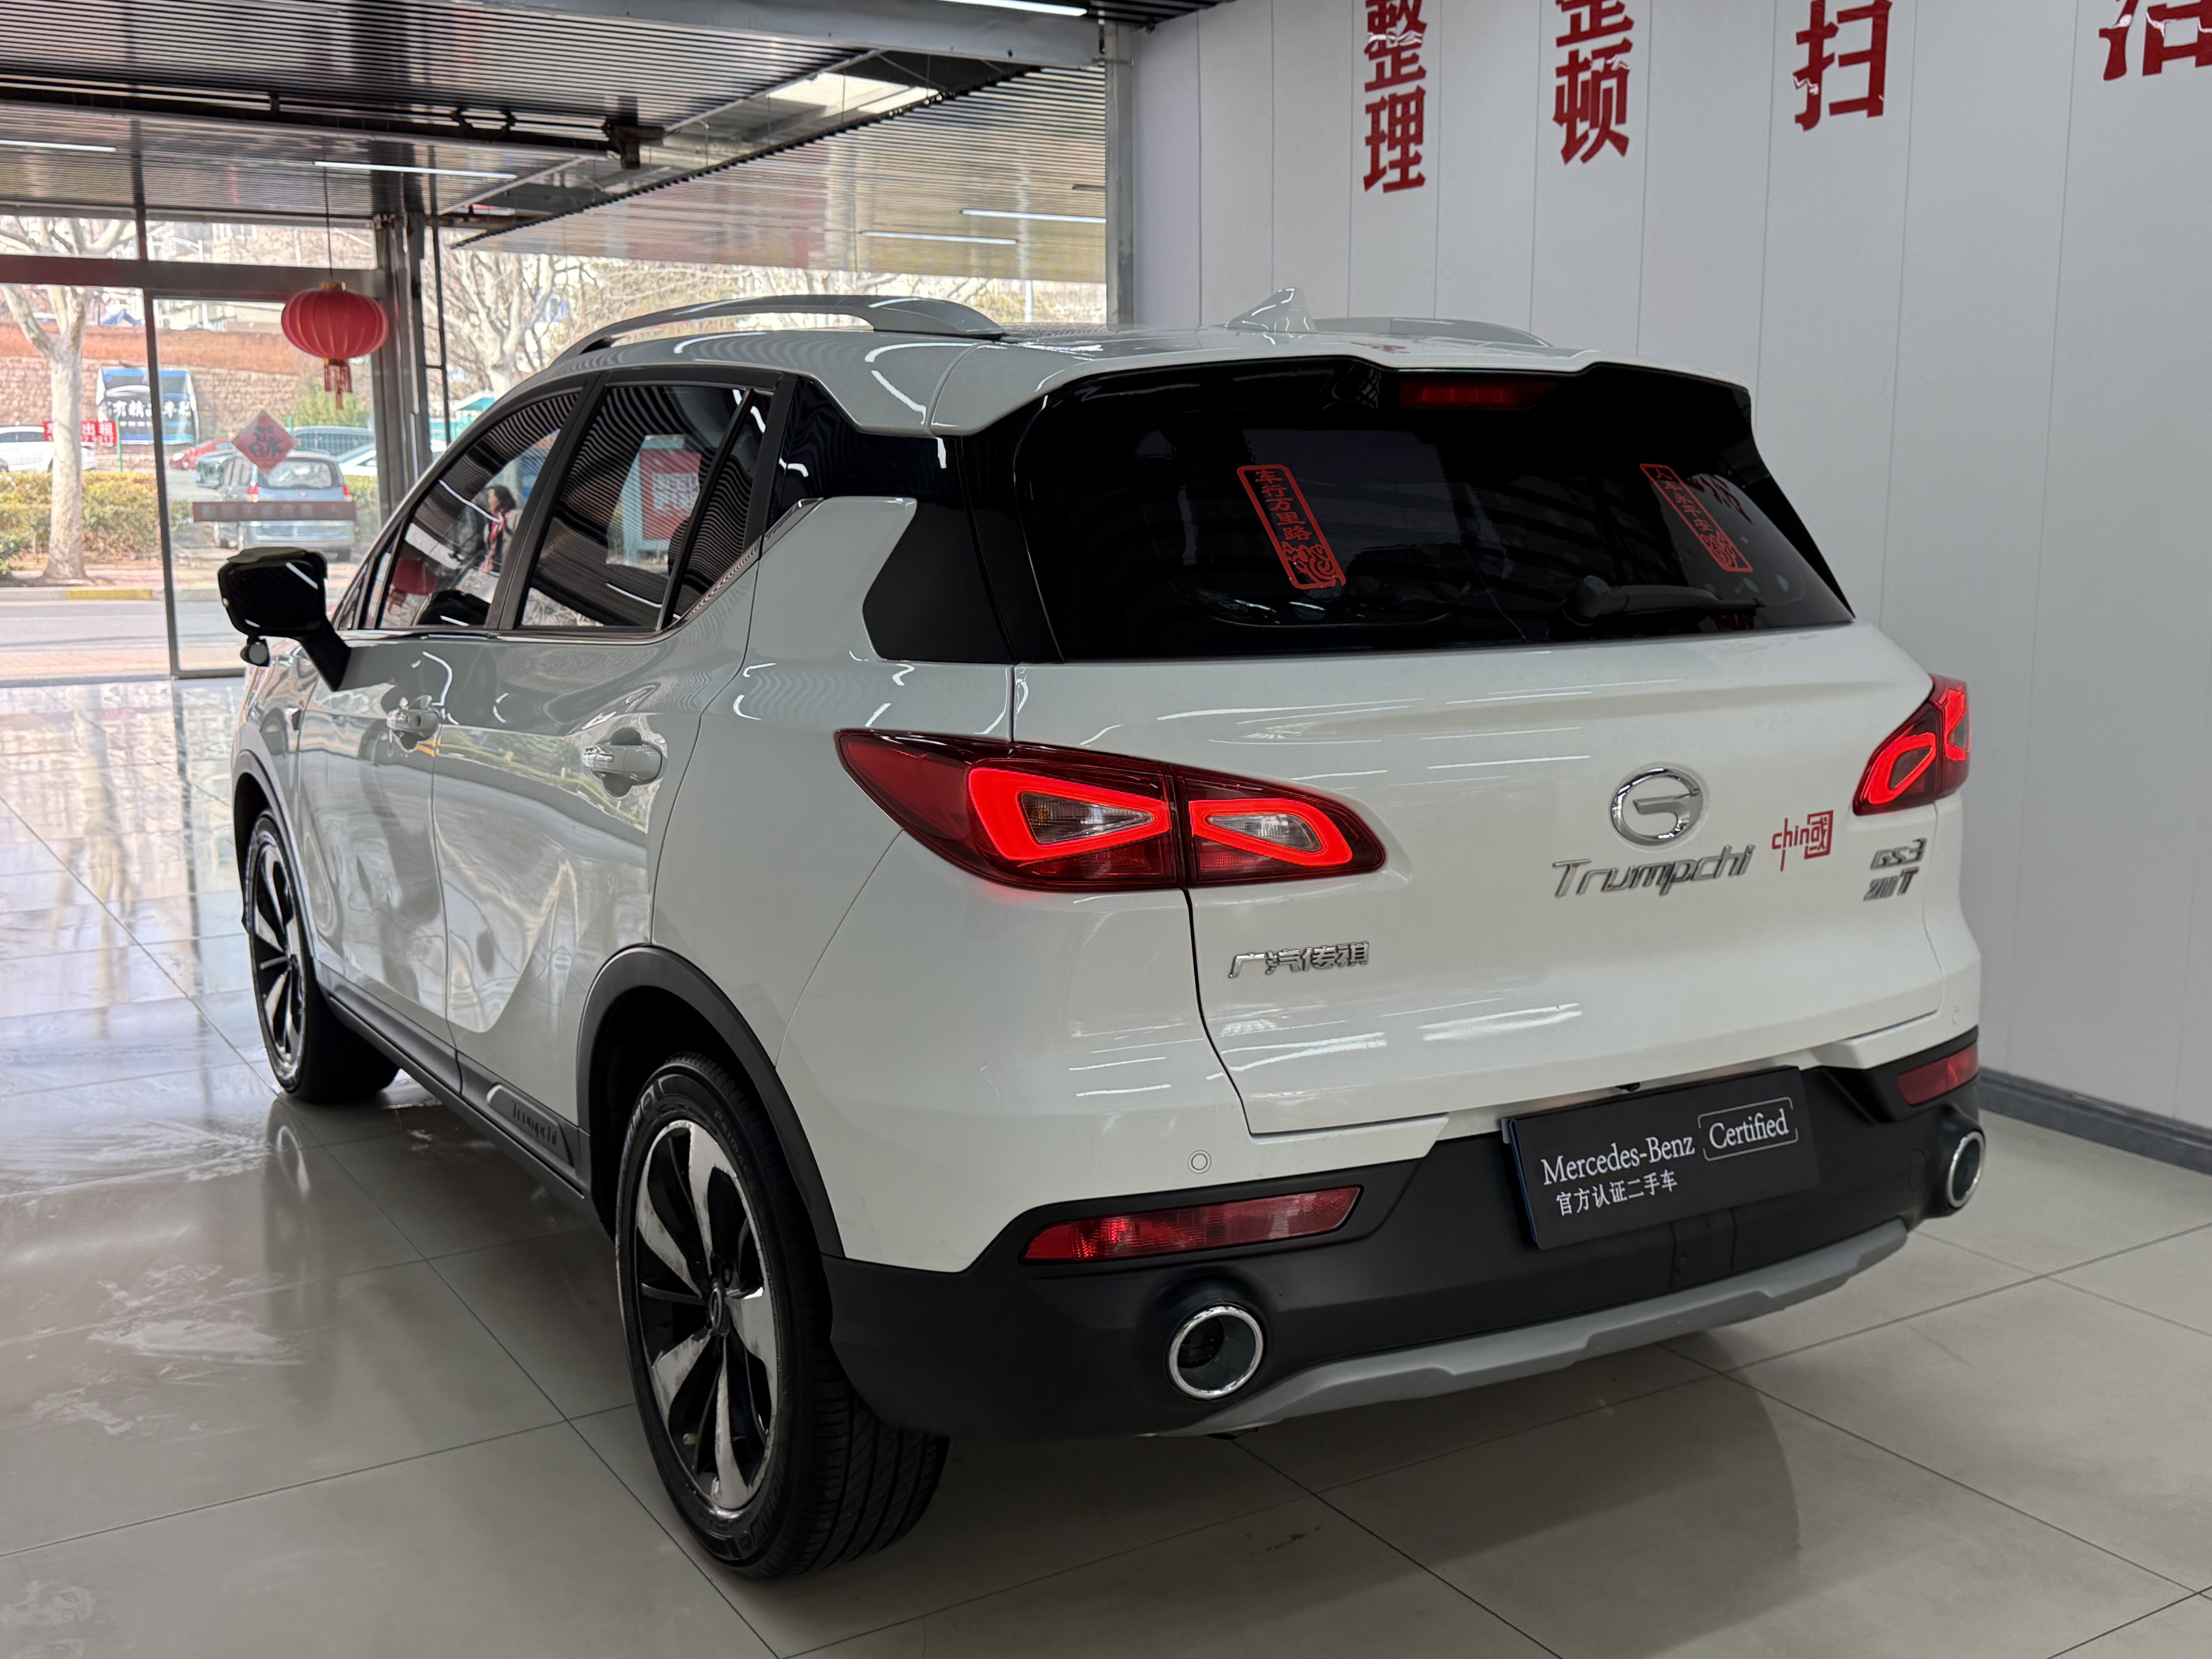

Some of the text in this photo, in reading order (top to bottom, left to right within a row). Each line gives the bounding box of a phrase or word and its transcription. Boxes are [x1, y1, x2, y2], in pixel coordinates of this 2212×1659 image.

[1363, 0, 1427, 193] 整理
[1793, 0, 1893, 132] 扫
[1255, 470, 1312, 541] 车行万里路
[1553, 843, 1756, 898] Trumpchi
[1870, 838, 1927, 870] GS3
[1228, 941, 1369, 979] 广汽传祺
[1540, 1108, 1789, 1185] Mercedes-Benz Certified
[1556, 1169, 1678, 1216] 官方认证二手车
